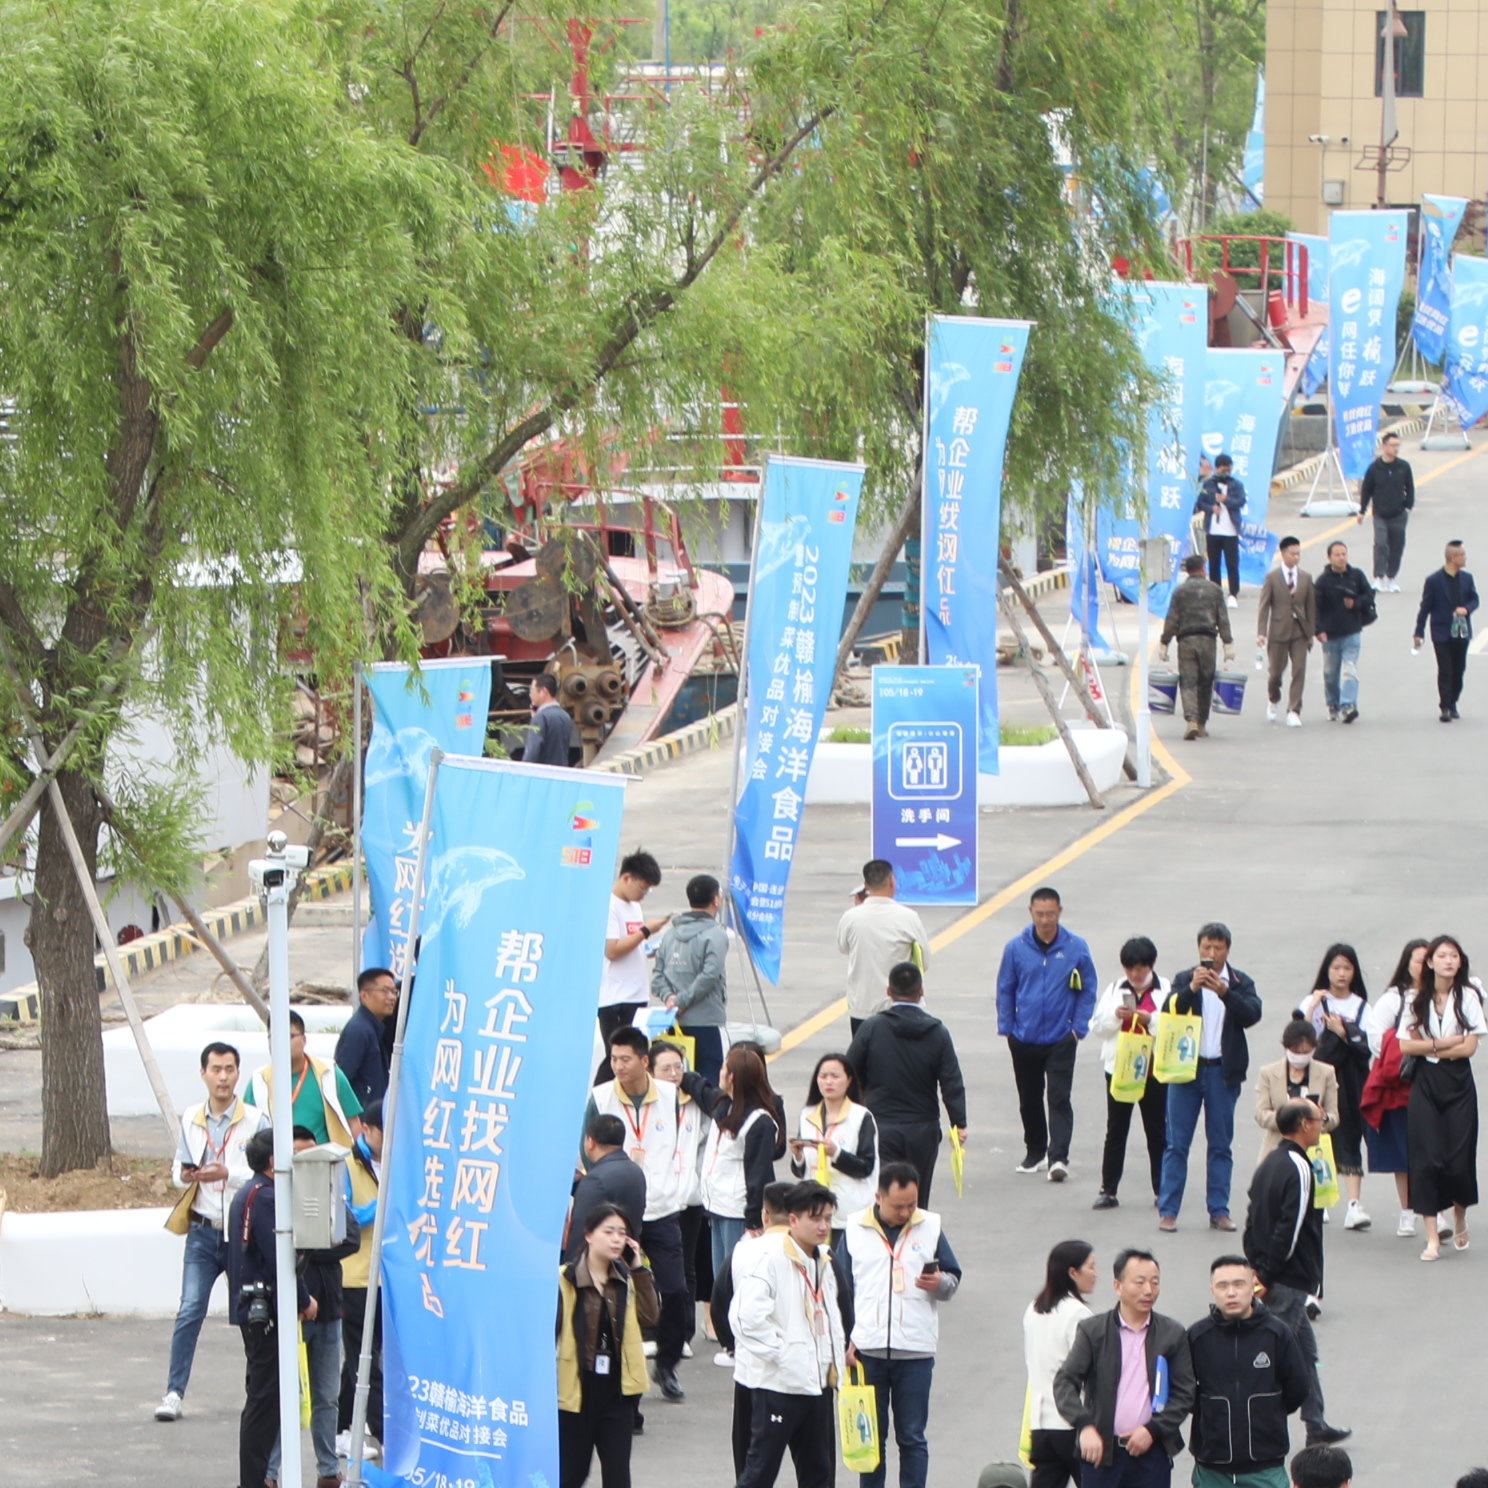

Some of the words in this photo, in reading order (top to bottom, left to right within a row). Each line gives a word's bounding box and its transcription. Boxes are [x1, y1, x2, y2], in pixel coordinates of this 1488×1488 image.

[900, 808, 950, 824] 洗手间
[442, 929, 545, 1271] 帮企业找网红
